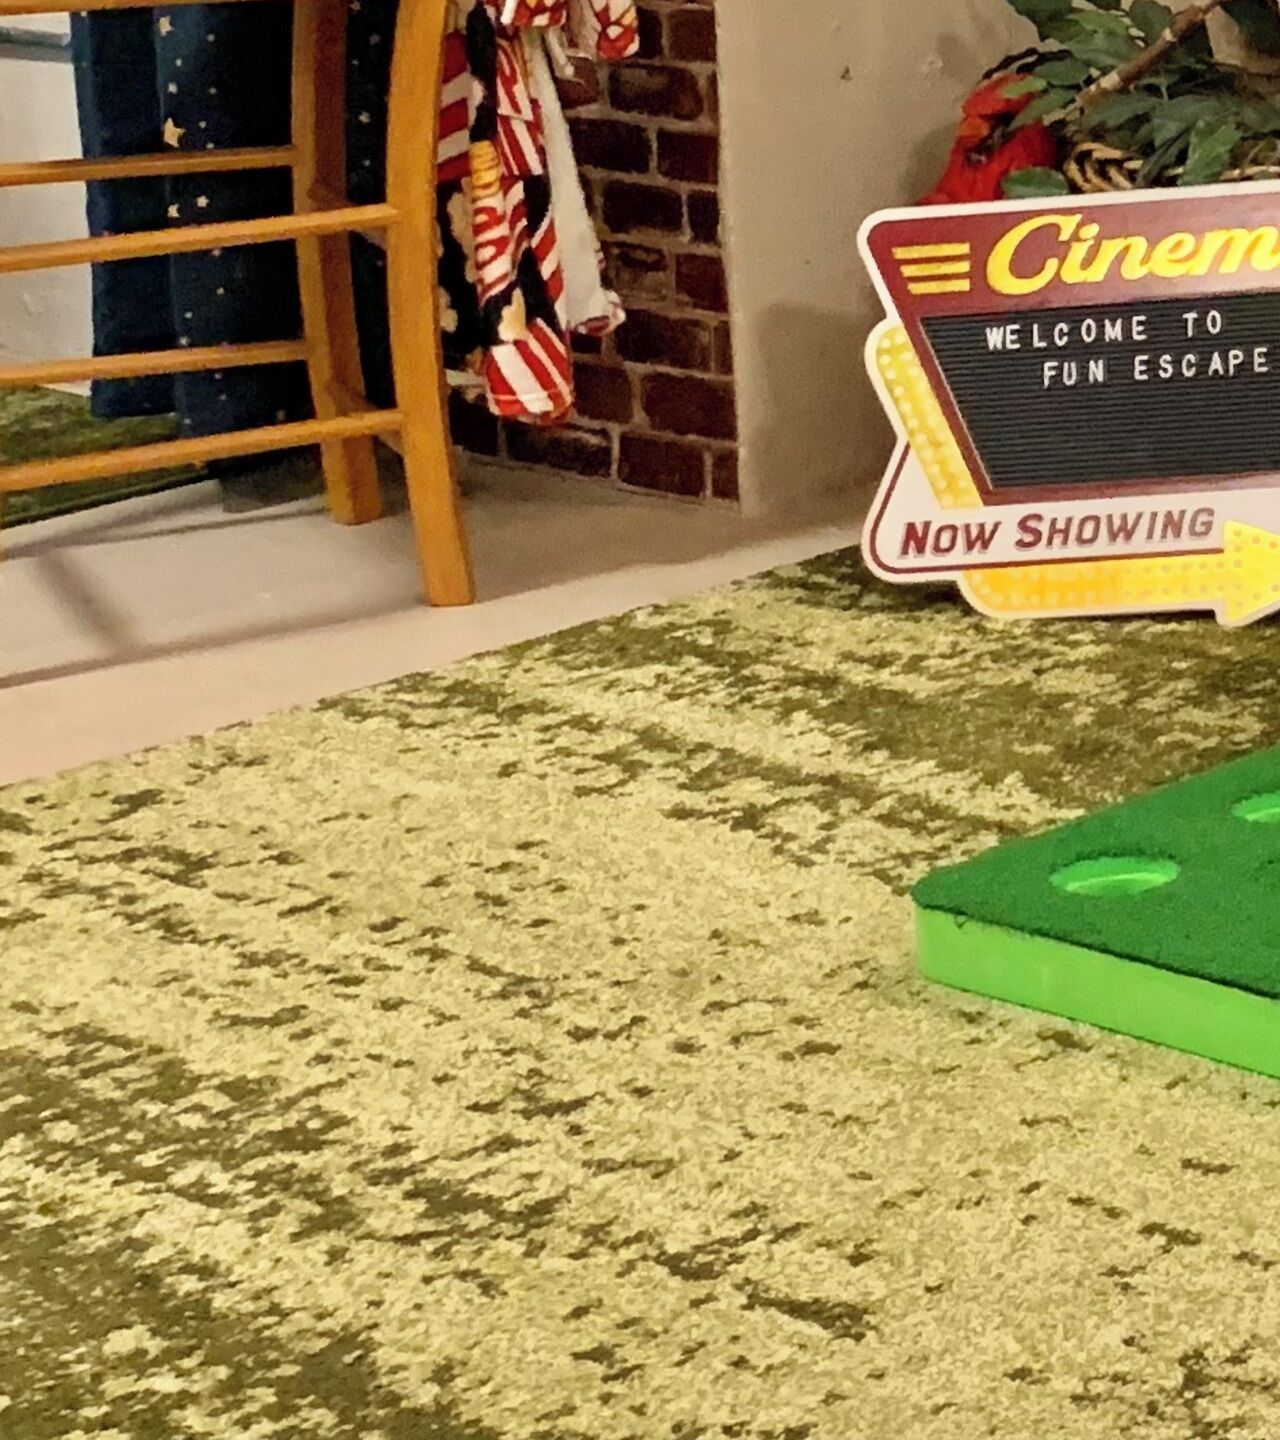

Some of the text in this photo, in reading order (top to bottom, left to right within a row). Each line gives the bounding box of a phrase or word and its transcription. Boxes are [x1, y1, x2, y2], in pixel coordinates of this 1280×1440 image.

[985, 309, 1224, 351] WELCOME TO
[1043, 359, 1105, 388] FUN
[1133, 347, 1269, 381] ESCAPE
